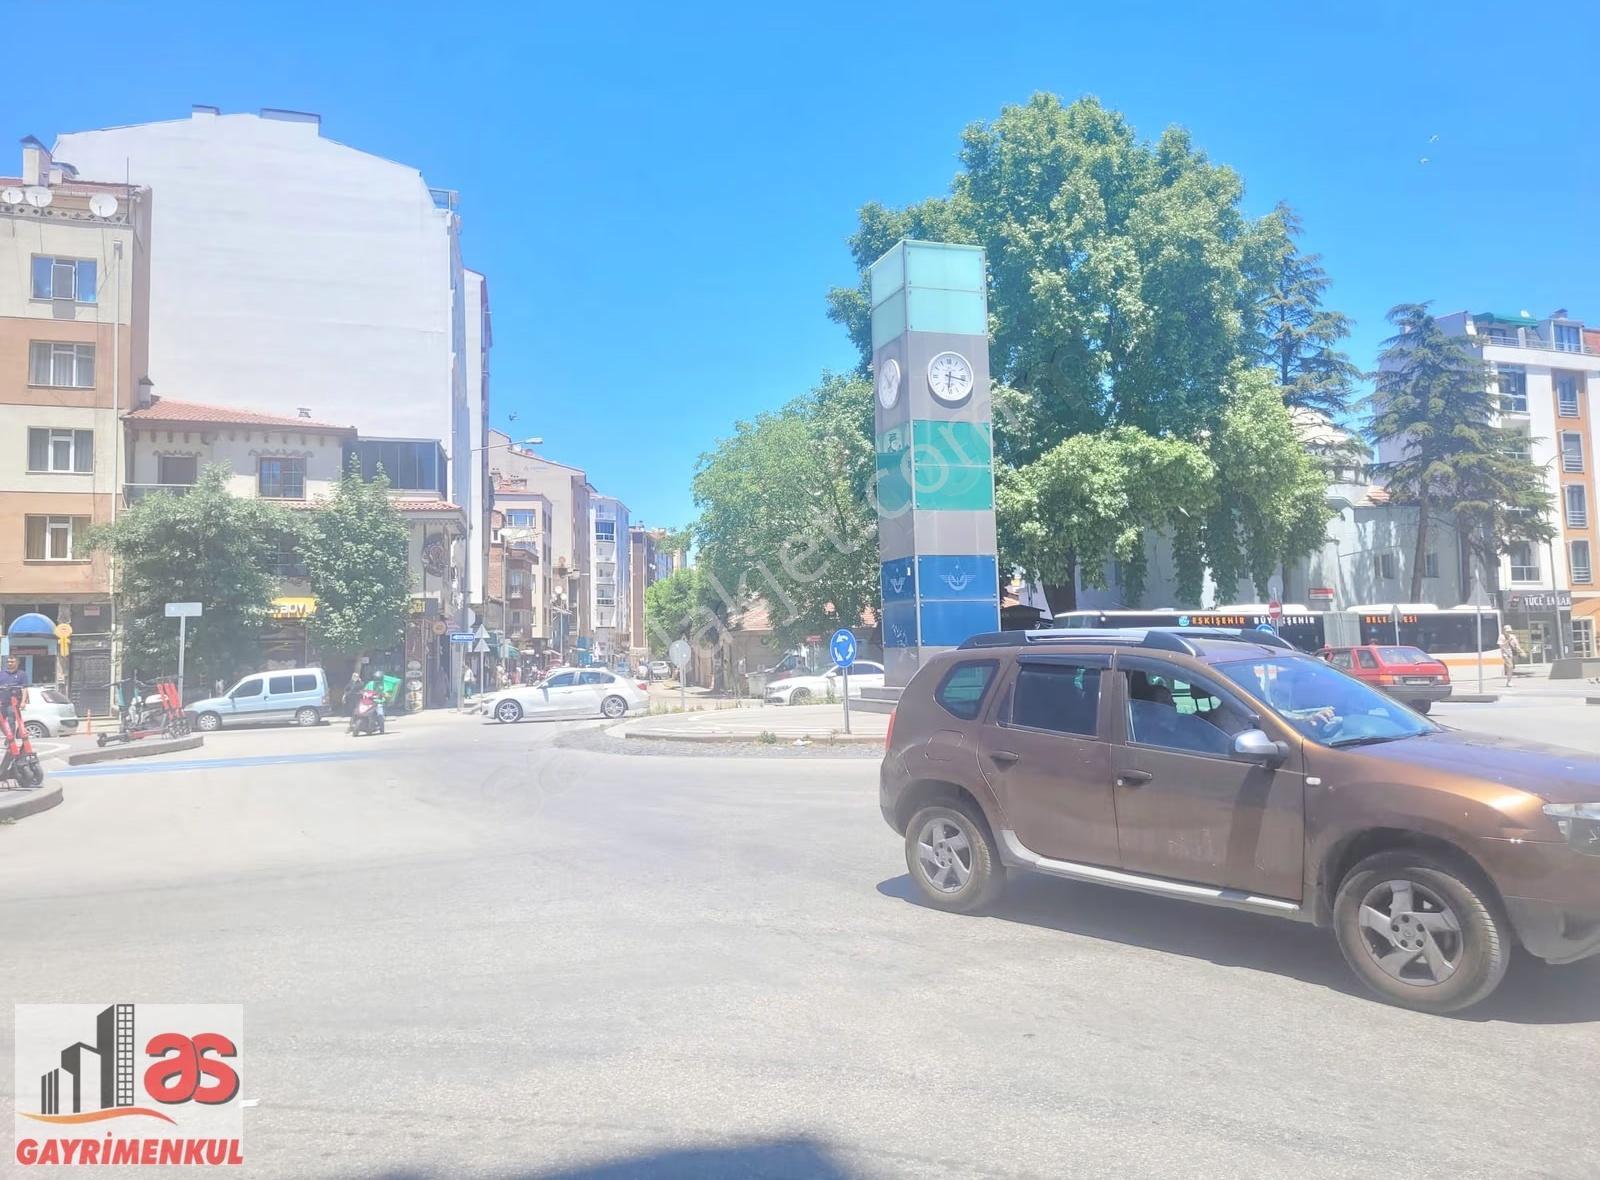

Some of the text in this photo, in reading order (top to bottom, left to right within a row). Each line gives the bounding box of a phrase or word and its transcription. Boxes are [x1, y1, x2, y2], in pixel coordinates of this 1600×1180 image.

[1192, 614, 1418, 626] ESKİŞEHİR BÜYŞEHİR BELEESİ
